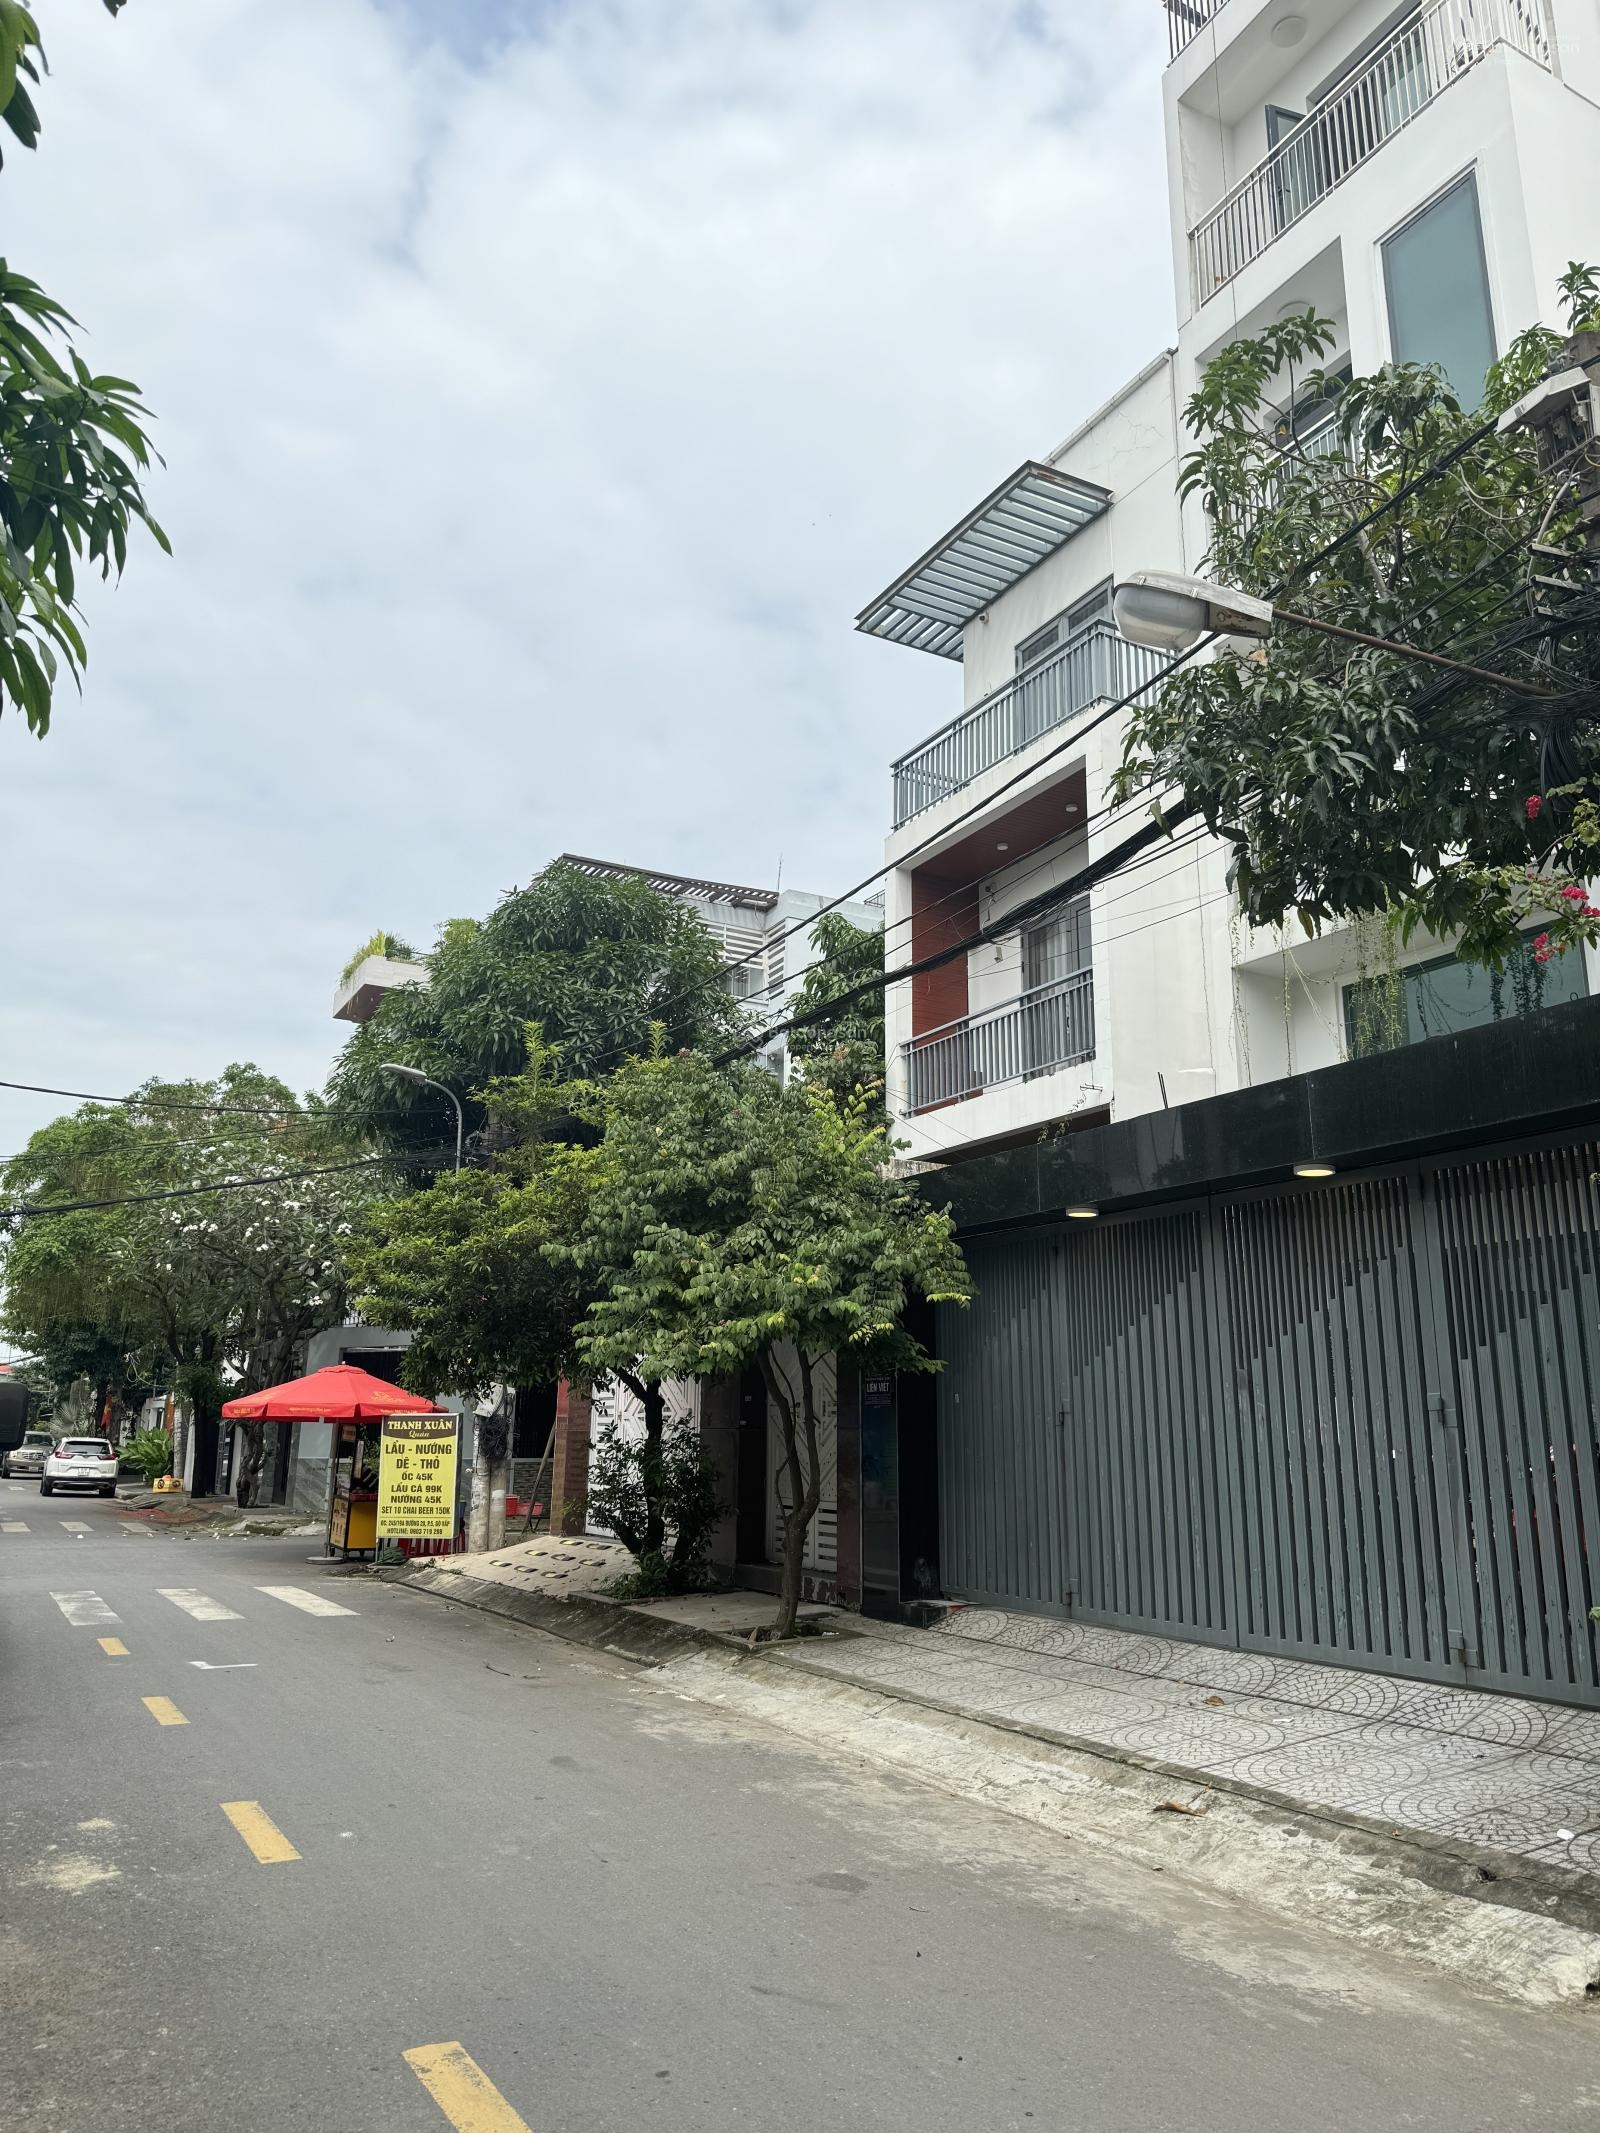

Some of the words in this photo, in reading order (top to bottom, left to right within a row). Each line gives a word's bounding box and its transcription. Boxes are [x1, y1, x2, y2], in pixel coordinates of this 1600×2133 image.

[387, 1421, 422, 1430] THANH
[423, 1419, 453, 1430] XUÂN
[385, 1440, 405, 1454] LẨU
[415, 1442, 452, 1454] NƯỚNG
[420, 1456, 440, 1469] THỎ
[402, 1471, 414, 1481] ỐC
[416, 1473, 433, 1481] 45K
[411, 1484, 423, 1493] CÁ
[425, 1485, 442, 1493] 99K
[425, 1496, 442, 1504] 45K
[381, 1506, 392, 1514] SET
[403, 1507, 417, 1515] CHAI
[418, 1507, 434, 1515] BEER
[436, 1507, 451, 1515] 150K
